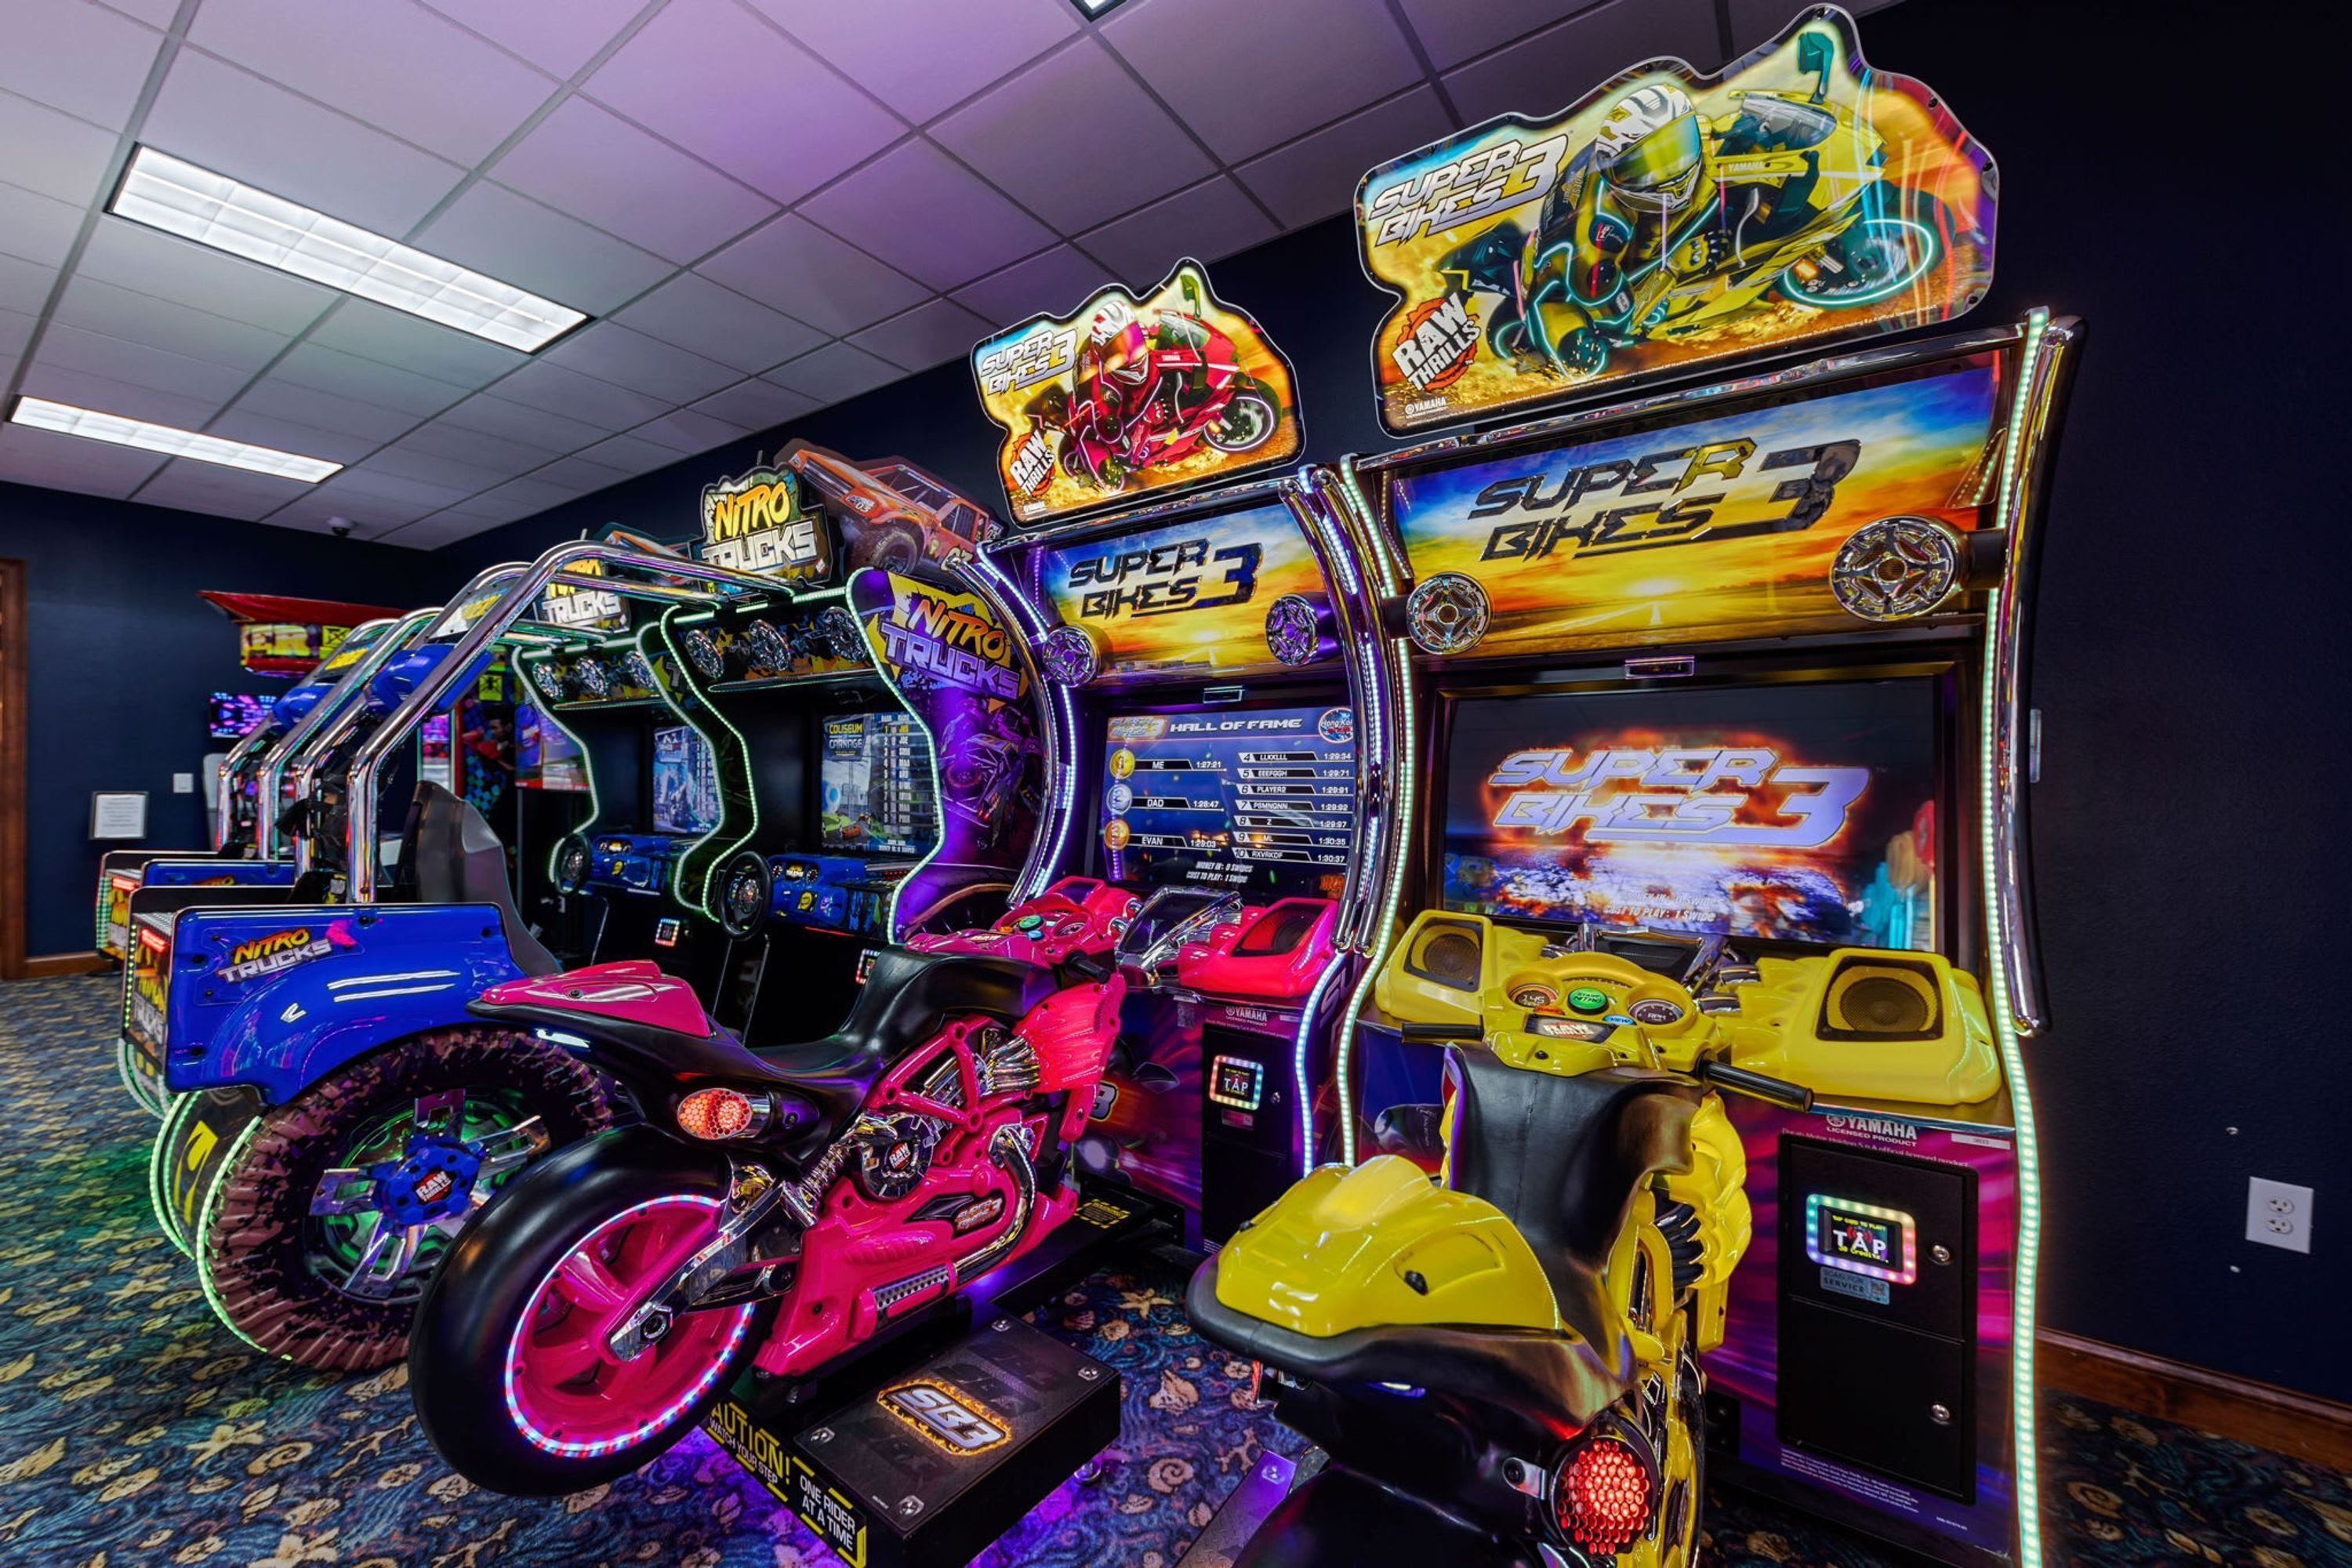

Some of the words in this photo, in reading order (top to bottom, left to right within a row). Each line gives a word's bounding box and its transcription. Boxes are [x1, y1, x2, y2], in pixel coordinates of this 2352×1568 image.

[1368, 140, 1523, 220] SUPER
[1376, 175, 1509, 247] BIKES
[981, 329, 1054, 377] SUPER
[1392, 292, 1468, 378] RAW
[1408, 320, 1480, 390] THRILLS
[987, 354, 1051, 395] BIKES
[1414, 397, 1446, 412] YAMAHA
[1010, 430, 1047, 487] RAW
[1022, 449, 1055, 496] THRILLS
[1467, 437, 1758, 520] SUPER
[701, 520, 817, 572] TRUCKS
[1479, 493, 1724, 563] BIKES
[1069, 538, 1210, 588] SUPER
[541, 591, 622, 623] TRUCKS
[1081, 576, 1201, 620] BIKES
[881, 622, 1020, 699] TRUCKS
[829, 724, 862, 734] COLISEUM
[829, 739, 862, 749] CARNAGE
[1170, 722, 1217, 734] HALL
[1220, 720, 1241, 731] OF
[1246, 718, 1303, 730] FAME
[1490, 748, 1777, 792] SUPER
[1146, 799, 1164, 808] DAD
[1494, 792, 1746, 834] BIKES
[1142, 837, 1163, 846] EVAN
[1235, 849, 1246, 858] 10
[217, 938, 332, 982] TRUCKS
[1236, 1007, 1268, 1022] YAMAHA
[1225, 1077, 1249, 1092] TAP
[1826, 1127, 1871, 1139] LICENSED
[1872, 1134, 1918, 1147] PRODUCT
[1848, 1114, 1918, 1141] YAMAHA
[888, 1142, 911, 1167] RAW
[416, 1171, 448, 1200] RAW
[1833, 1230, 1887, 1255] TAP
[1824, 1276, 1866, 1293] SERVICE
[891, 1386, 1004, 1450] SB3
[710, 1403, 790, 1486] AUTION!
[710, 1417, 736, 1449] WATCH
[737, 1443, 758, 1469] YOUR
[758, 1461, 779, 1485] STEP
[800, 1475, 822, 1505] ONE
[823, 1494, 856, 1536] RIDER
[802, 1495, 816, 1516] AT
[817, 1508, 826, 1526] A
[827, 1515, 854, 1552] TIME
